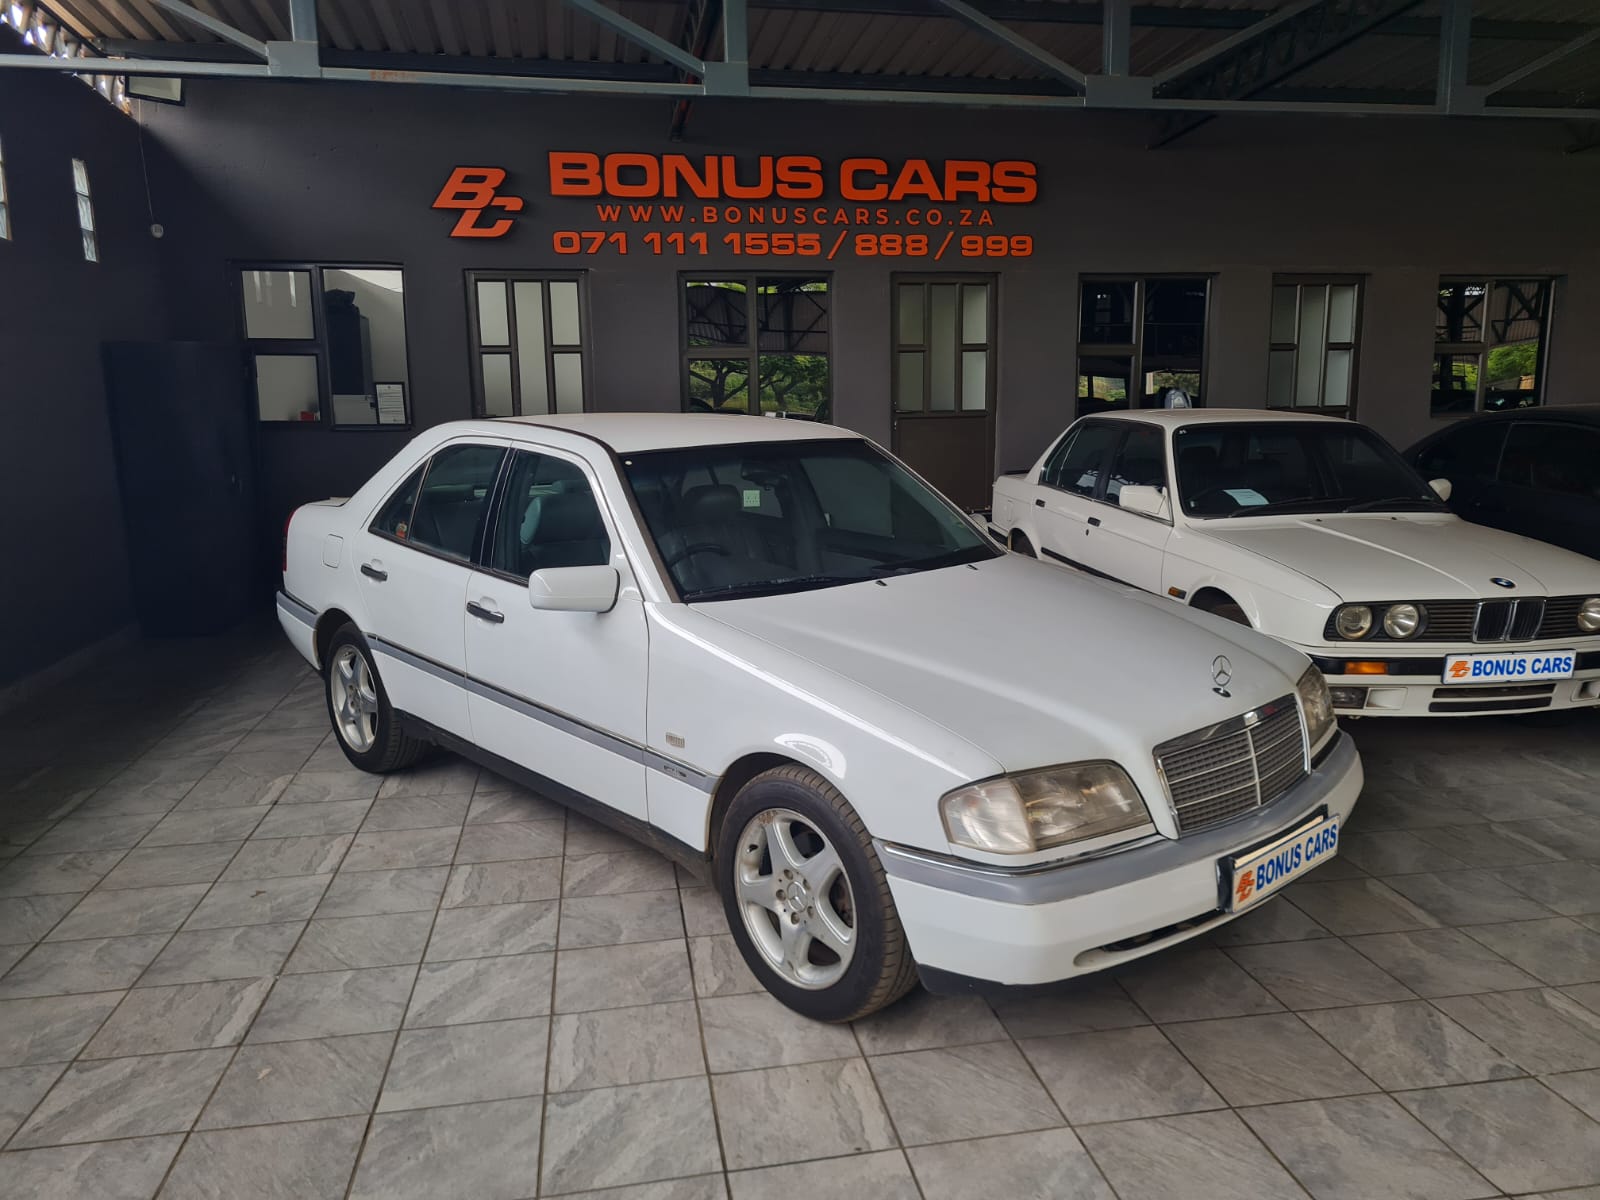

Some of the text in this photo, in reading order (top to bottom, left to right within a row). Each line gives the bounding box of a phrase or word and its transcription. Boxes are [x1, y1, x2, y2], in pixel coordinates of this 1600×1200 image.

[549, 151, 1038, 203] BONUS CARS
[596, 204, 994, 227] WWW.BONUSCARS.CO.ZA
[553, 231, 628, 255] 071
[643, 231, 709, 256] 111
[1472, 659, 1526, 676] BONUS
[1532, 657, 1572, 674] CARS
[1256, 843, 1302, 891] BONUS
[1305, 823, 1337, 862] CARS
